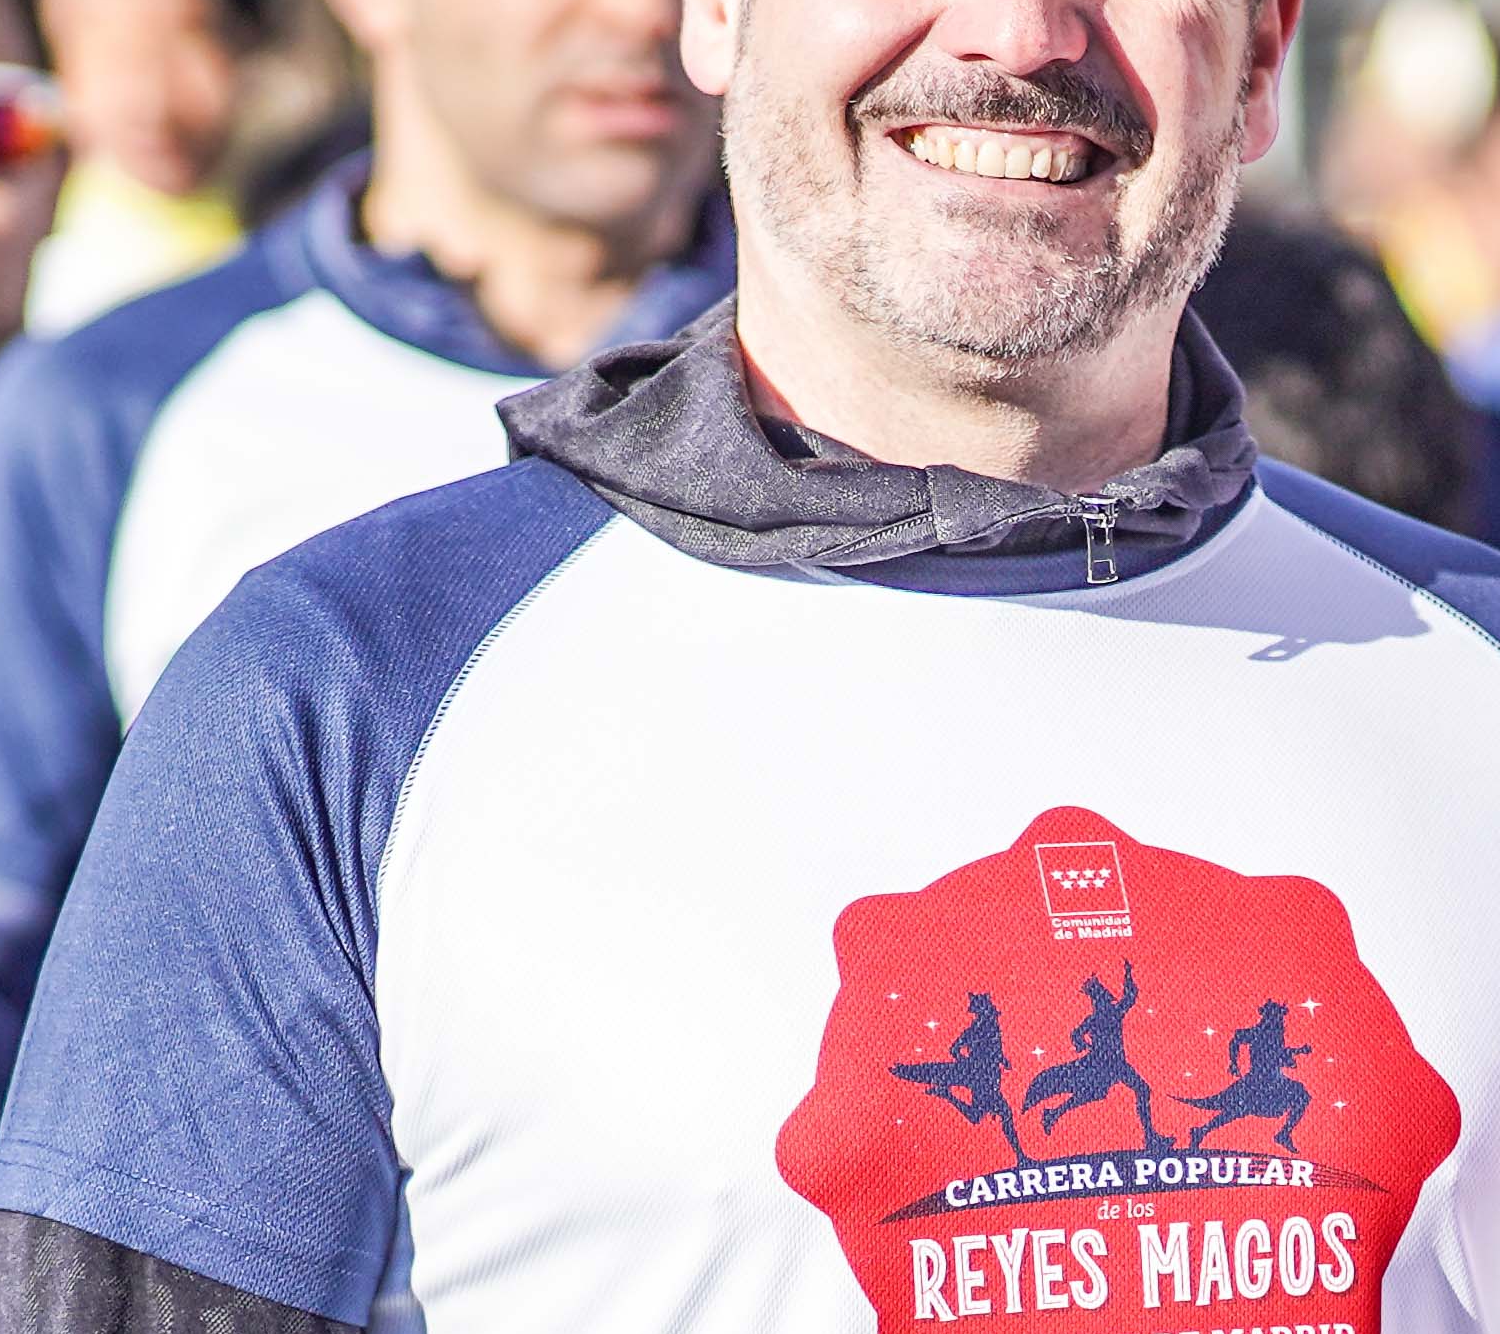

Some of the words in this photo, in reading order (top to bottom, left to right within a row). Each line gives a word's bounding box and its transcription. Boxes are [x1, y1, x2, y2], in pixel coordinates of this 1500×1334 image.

[1051, 916, 1130, 927] Comunidad
[1054, 929, 1073, 939] de
[1078, 926, 1132, 939] Madrid
[945, 1161, 1122, 1208] CARRERA
[1134, 1157, 1315, 1188] POPULAR
[1096, 1200, 1122, 1222] de
[1127, 1196, 1156, 1220] los
[909, 1226, 1106, 1323] REYES
[1138, 1211, 1357, 1308] MAGOS
